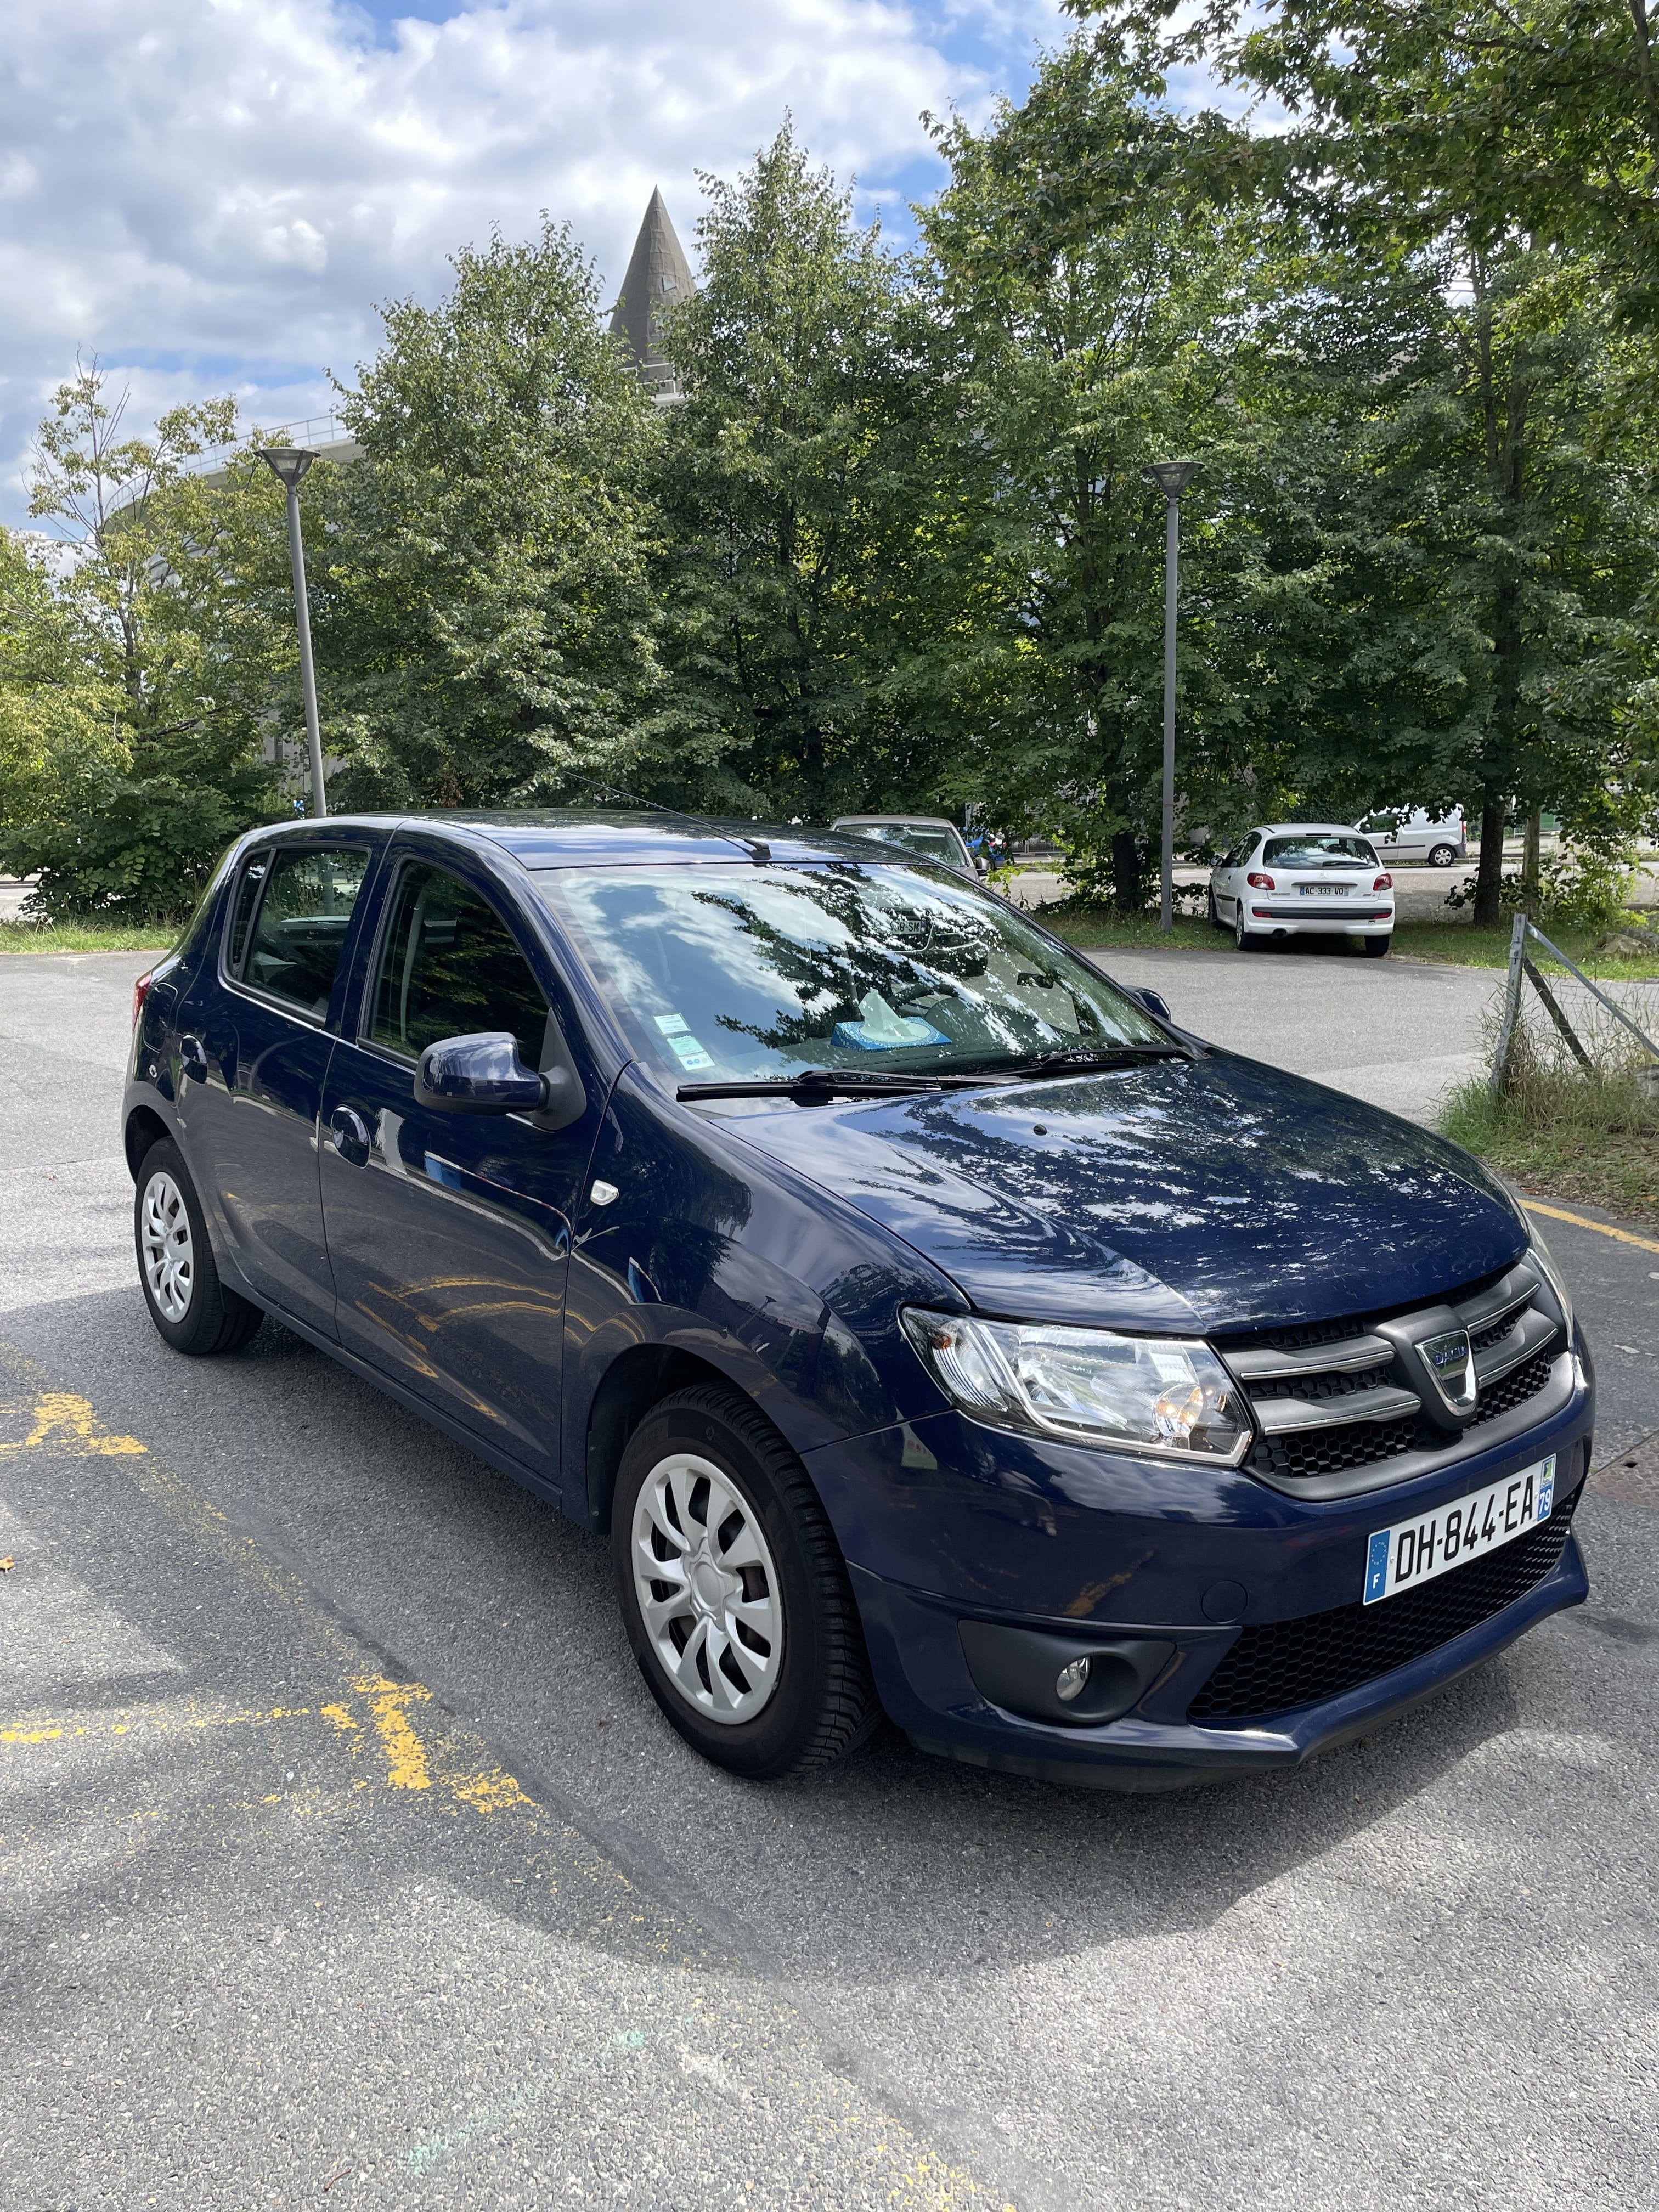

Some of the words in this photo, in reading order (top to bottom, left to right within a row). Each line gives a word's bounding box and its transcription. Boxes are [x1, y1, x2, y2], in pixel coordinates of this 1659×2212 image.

[1435, 1346, 1467, 1365] DACIA
[1539, 1489, 1551, 1515] 79
[1395, 1475, 1533, 1583] DH-844-EA
[1373, 1573, 1380, 1589] F
